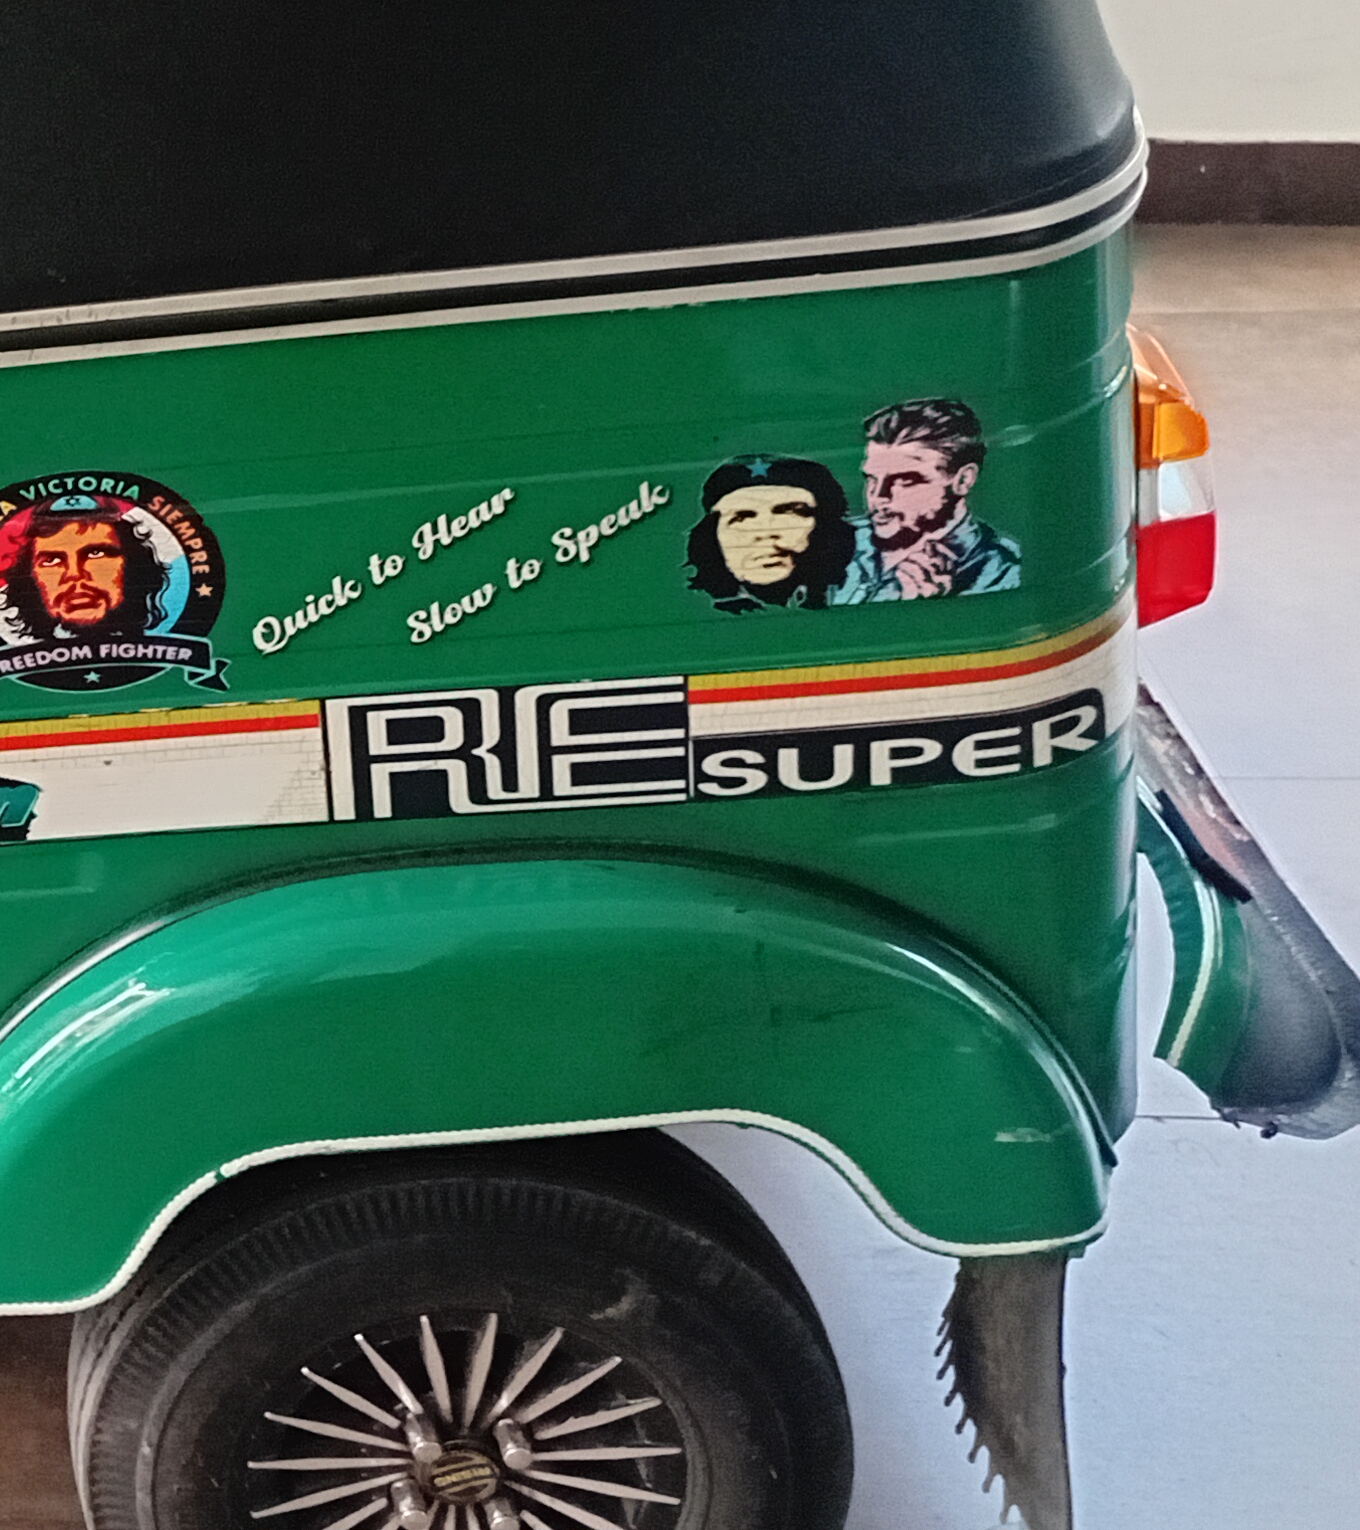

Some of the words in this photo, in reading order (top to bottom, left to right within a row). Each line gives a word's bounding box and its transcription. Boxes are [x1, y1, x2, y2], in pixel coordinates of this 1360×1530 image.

[19, 475, 141, 503] VICTORIA
[147, 494, 211, 576] SIEMPRE
[251, 574, 363, 655] Quick
[367, 552, 406, 587] to
[411, 486, 516, 561] Hear
[405, 582, 498, 645] Slow
[504, 556, 543, 590] to
[550, 480, 672, 564] Speak
[98, 642, 194, 662] FIGHTER
[696, 703, 1103, 798] SUPER
